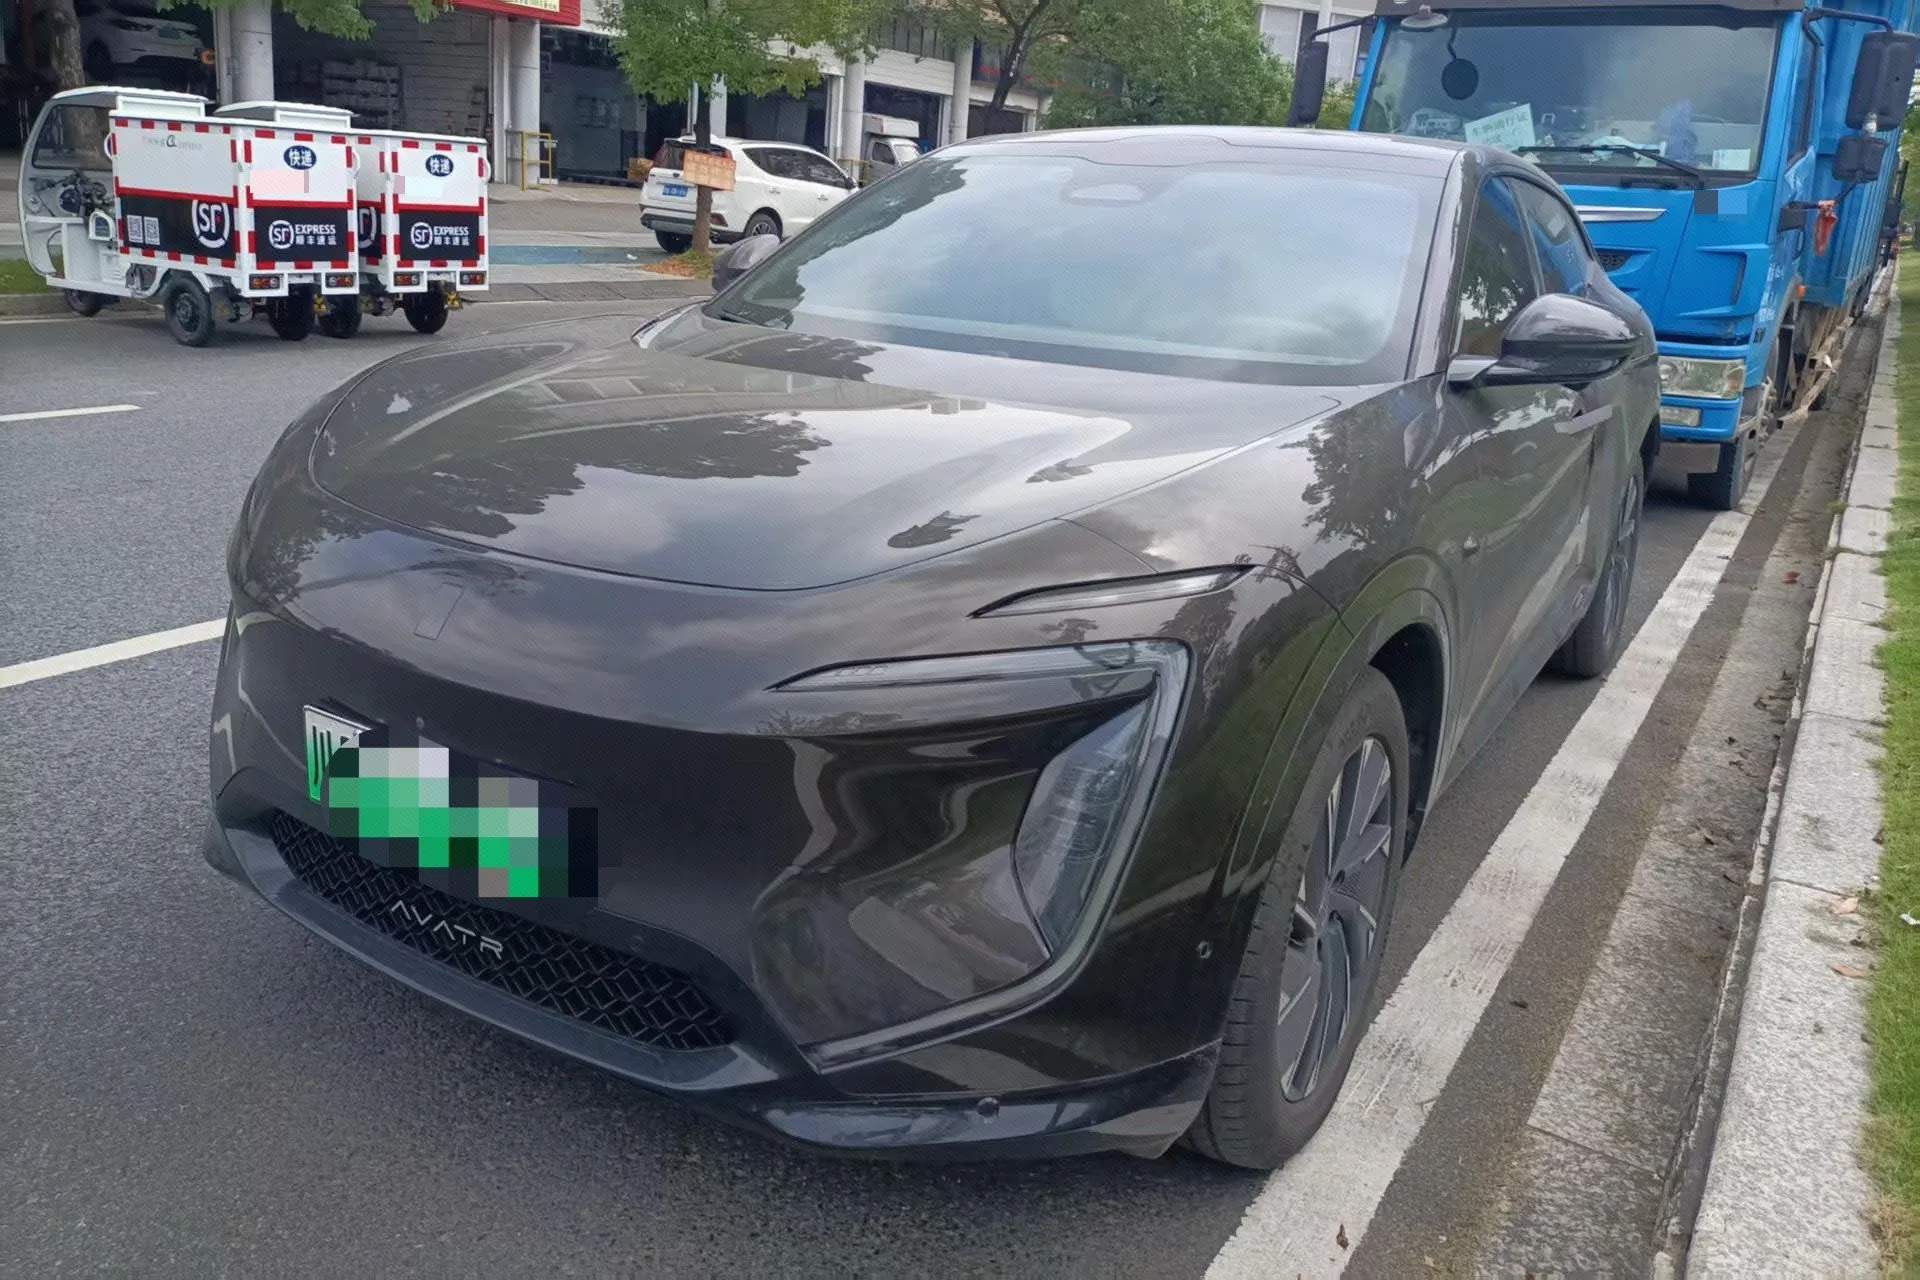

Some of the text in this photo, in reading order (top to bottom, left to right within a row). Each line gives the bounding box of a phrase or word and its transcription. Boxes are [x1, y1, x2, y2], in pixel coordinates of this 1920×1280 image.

[289, 148, 312, 166] 快递
[429, 157, 451, 174] 快递
[295, 224, 336, 234] EXPRESS
[433, 226, 469, 236] EXPRESS
